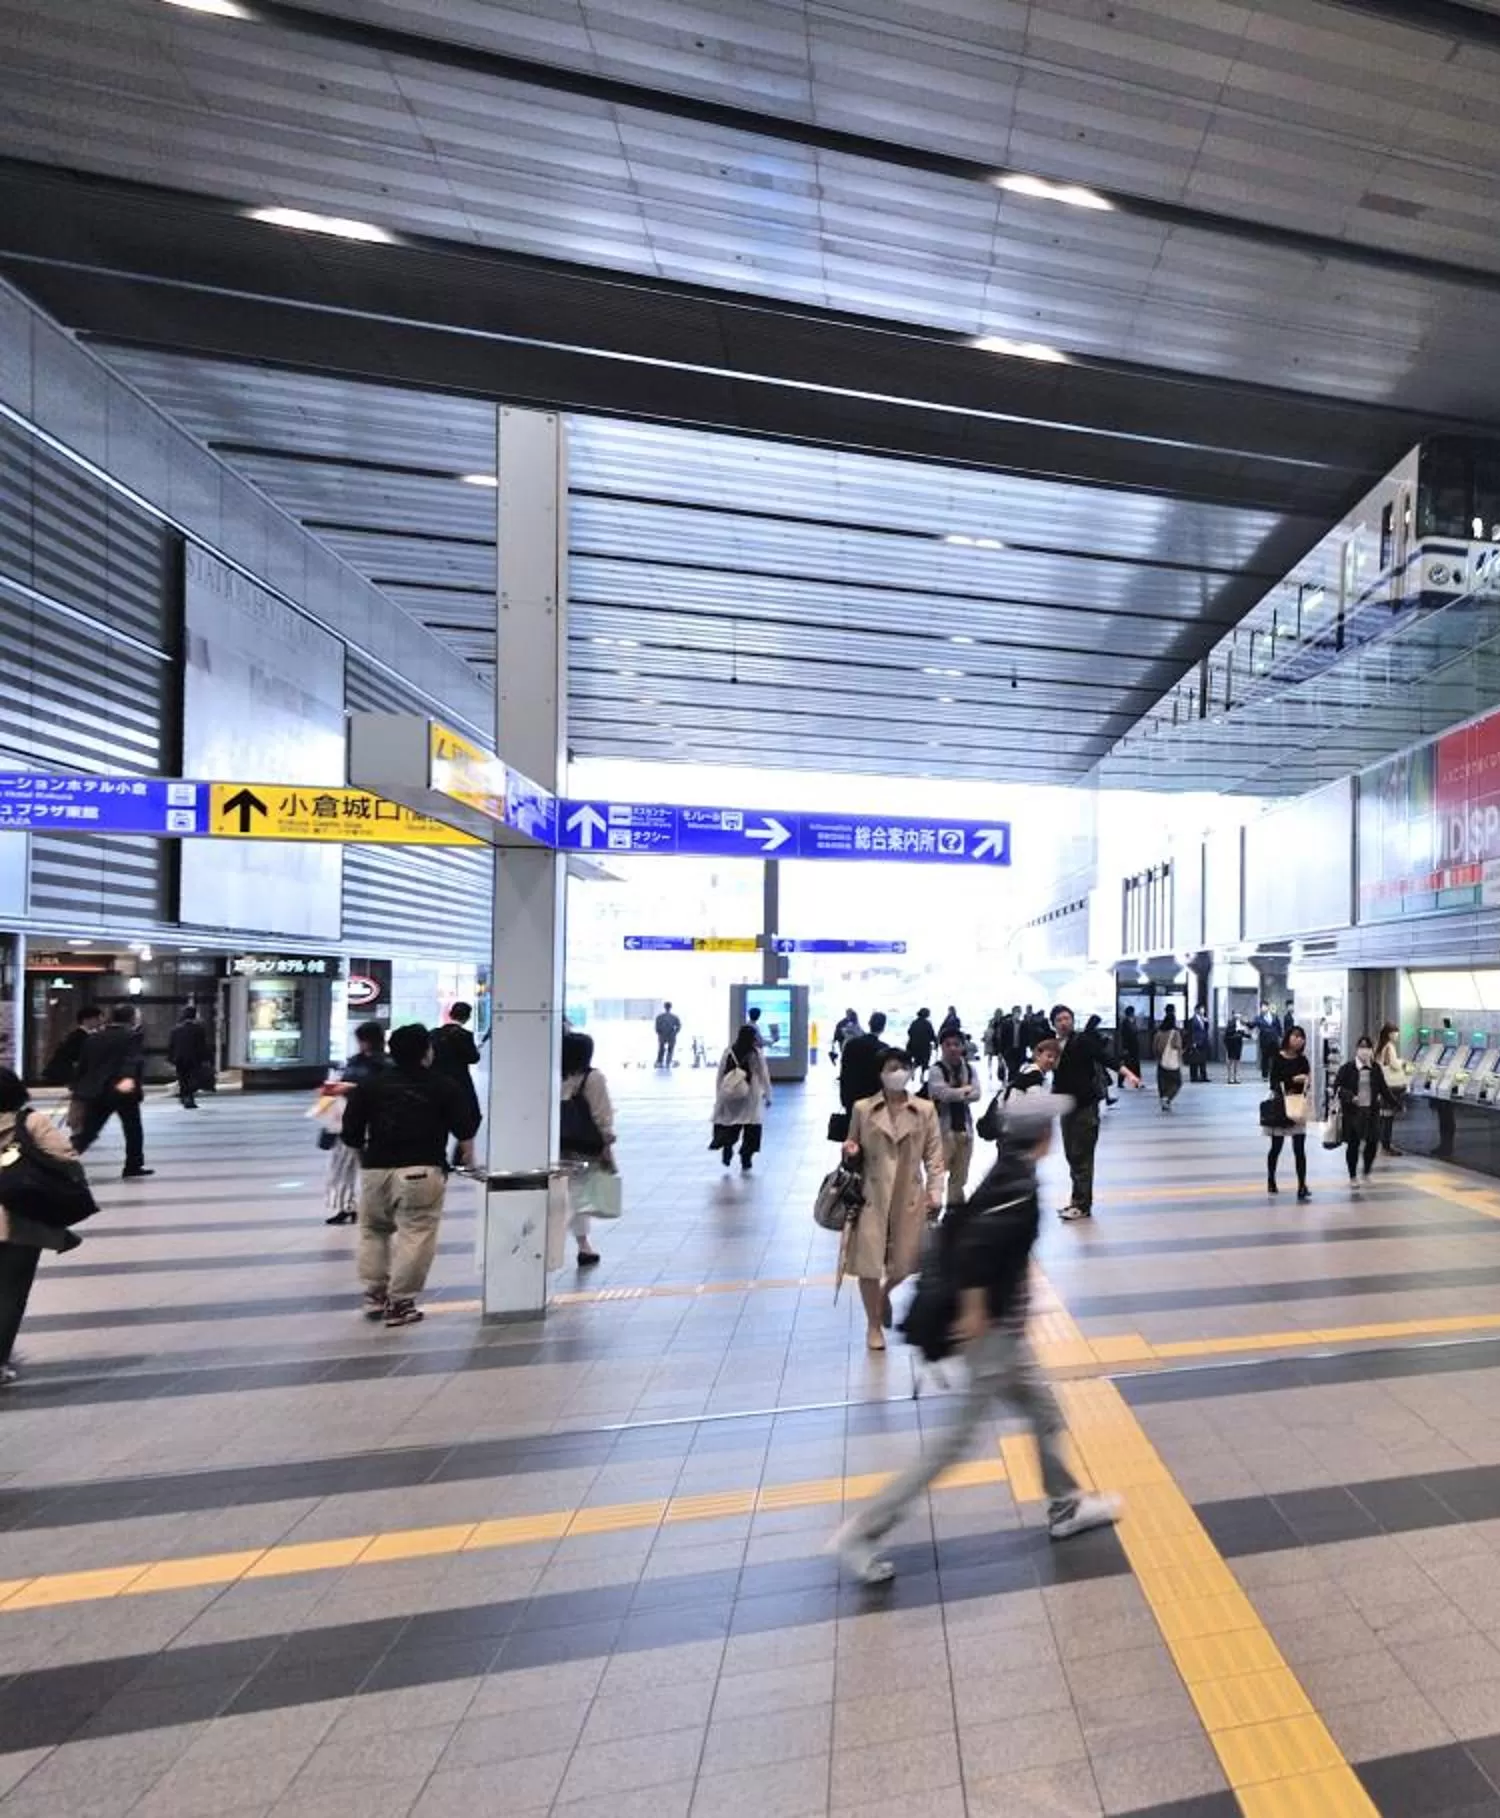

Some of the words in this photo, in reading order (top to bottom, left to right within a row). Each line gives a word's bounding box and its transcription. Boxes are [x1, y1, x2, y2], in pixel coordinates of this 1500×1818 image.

[279, 792, 401, 821] 小倉城口
[854, 825, 936, 852] 総合案内所
